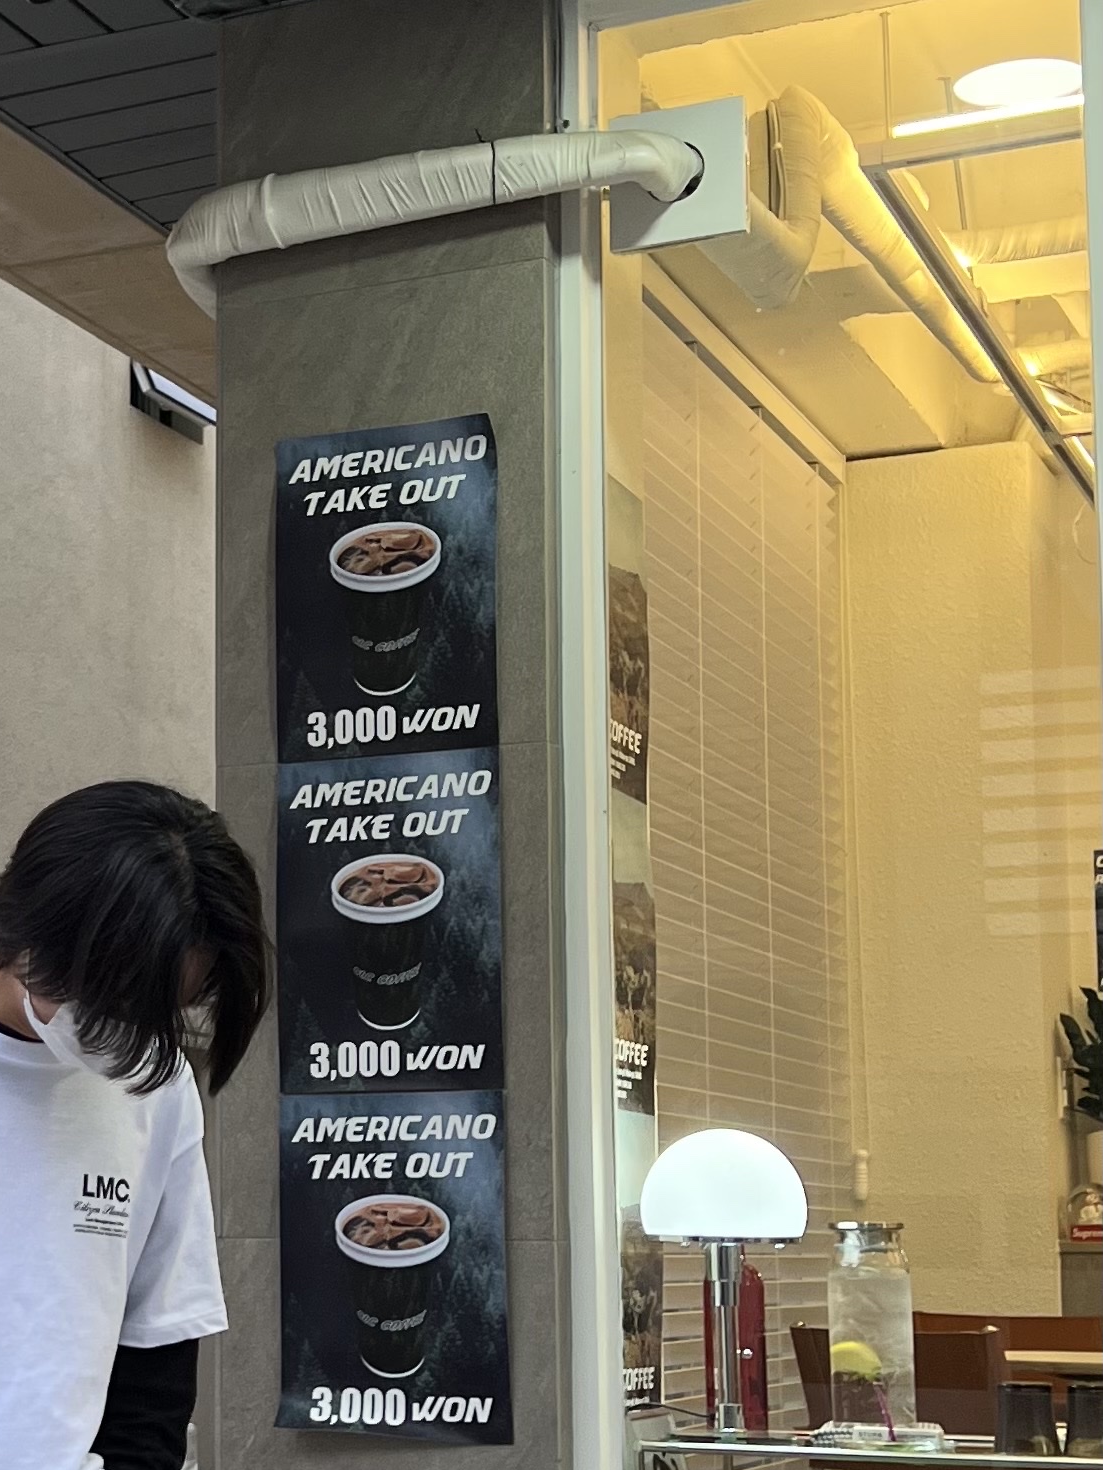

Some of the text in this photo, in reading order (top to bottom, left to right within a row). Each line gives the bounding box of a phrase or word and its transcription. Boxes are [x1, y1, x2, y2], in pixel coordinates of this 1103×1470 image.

[288, 434, 488, 485] AMERICANO
[303, 473, 467, 517] TAKE OUT
[307, 703, 481, 750] 3,000 WON
[289, 769, 493, 810] AMERICANO
[305, 808, 470, 844] TAKE OUT
[309, 1040, 486, 1082] 3,000 WON
[291, 1113, 497, 1143] AMERICANO
[307, 1151, 475, 1180] TAKE OUT
[309, 1386, 493, 1426] 3,000 WON
